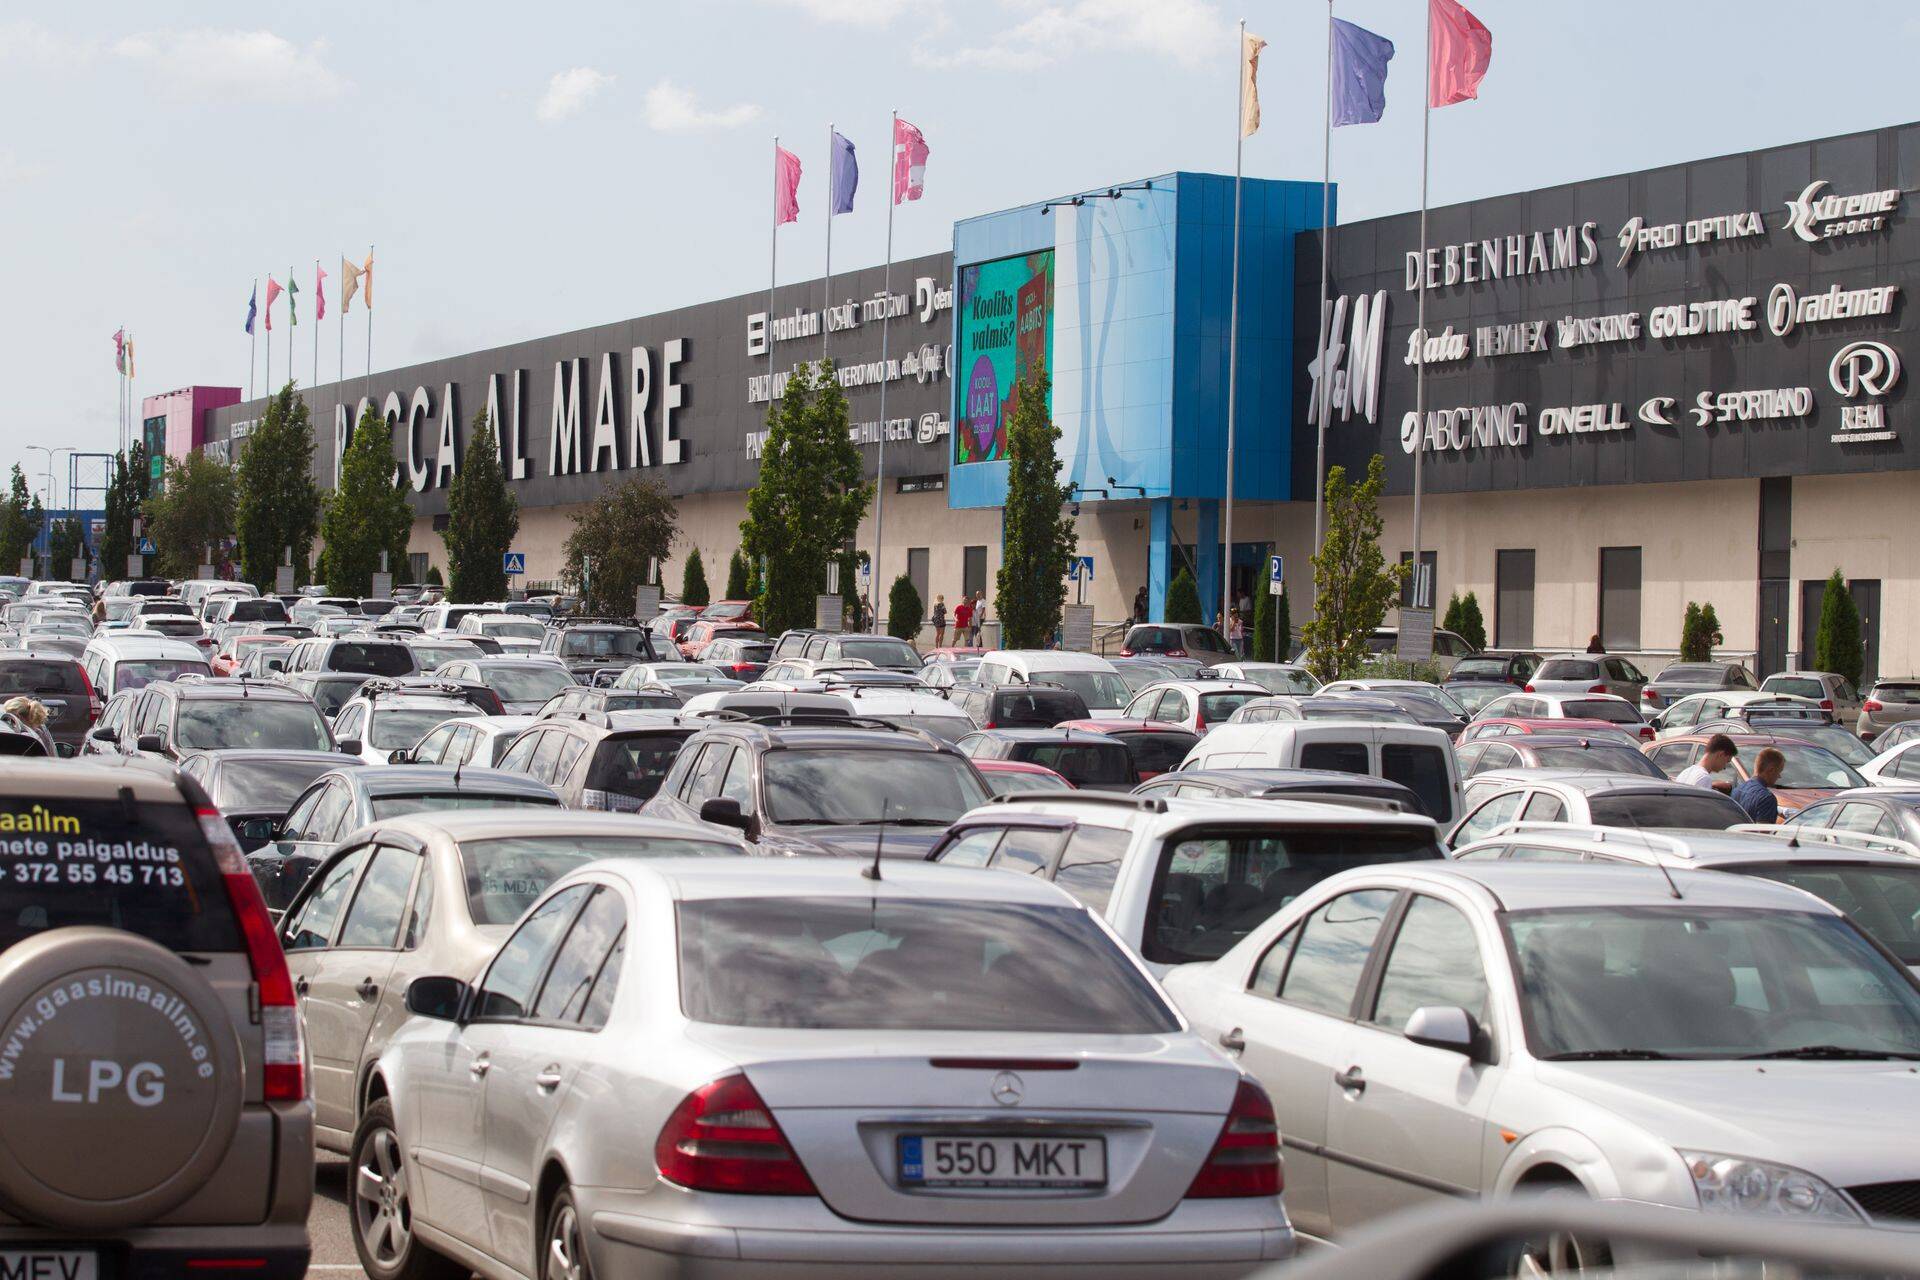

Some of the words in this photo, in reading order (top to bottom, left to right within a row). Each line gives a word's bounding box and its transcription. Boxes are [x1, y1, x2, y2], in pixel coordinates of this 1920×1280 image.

[1638, 223, 1682, 251] PRO
[1685, 211, 1765, 244] OPTIKA
[1823, 216, 1886, 238] SPORT
[1405, 221, 1598, 291] DEBENHAMS
[973, 289, 1013, 320] Kooliks
[1649, 296, 1757, 339] GOLDTIME
[973, 320, 1015, 351] valmis?
[1404, 326, 1470, 365] Bata
[838, 364, 867, 388] VERO
[1307, 289, 1387, 428] H&M
[548, 337, 690, 476] MARE
[971, 392, 994, 417] LAAT
[1717, 387, 1813, 422] SPORTLAND
[1840, 404, 1885, 430] REM
[57, 839, 180, 862] paigaldus
[15, 863, 60, 882] 372
[67, 864, 98, 882] 55
[103, 865, 134, 884] 45
[140, 866, 184, 886] 713
[503, 879, 541, 894] MDA
[0, 974, 214, 1081] www.gaasimaailm.ee
[51, 1058, 166, 1107] LPG
[935, 1141, 997, 1176] 550
[1013, 1143, 1086, 1177] MKT
